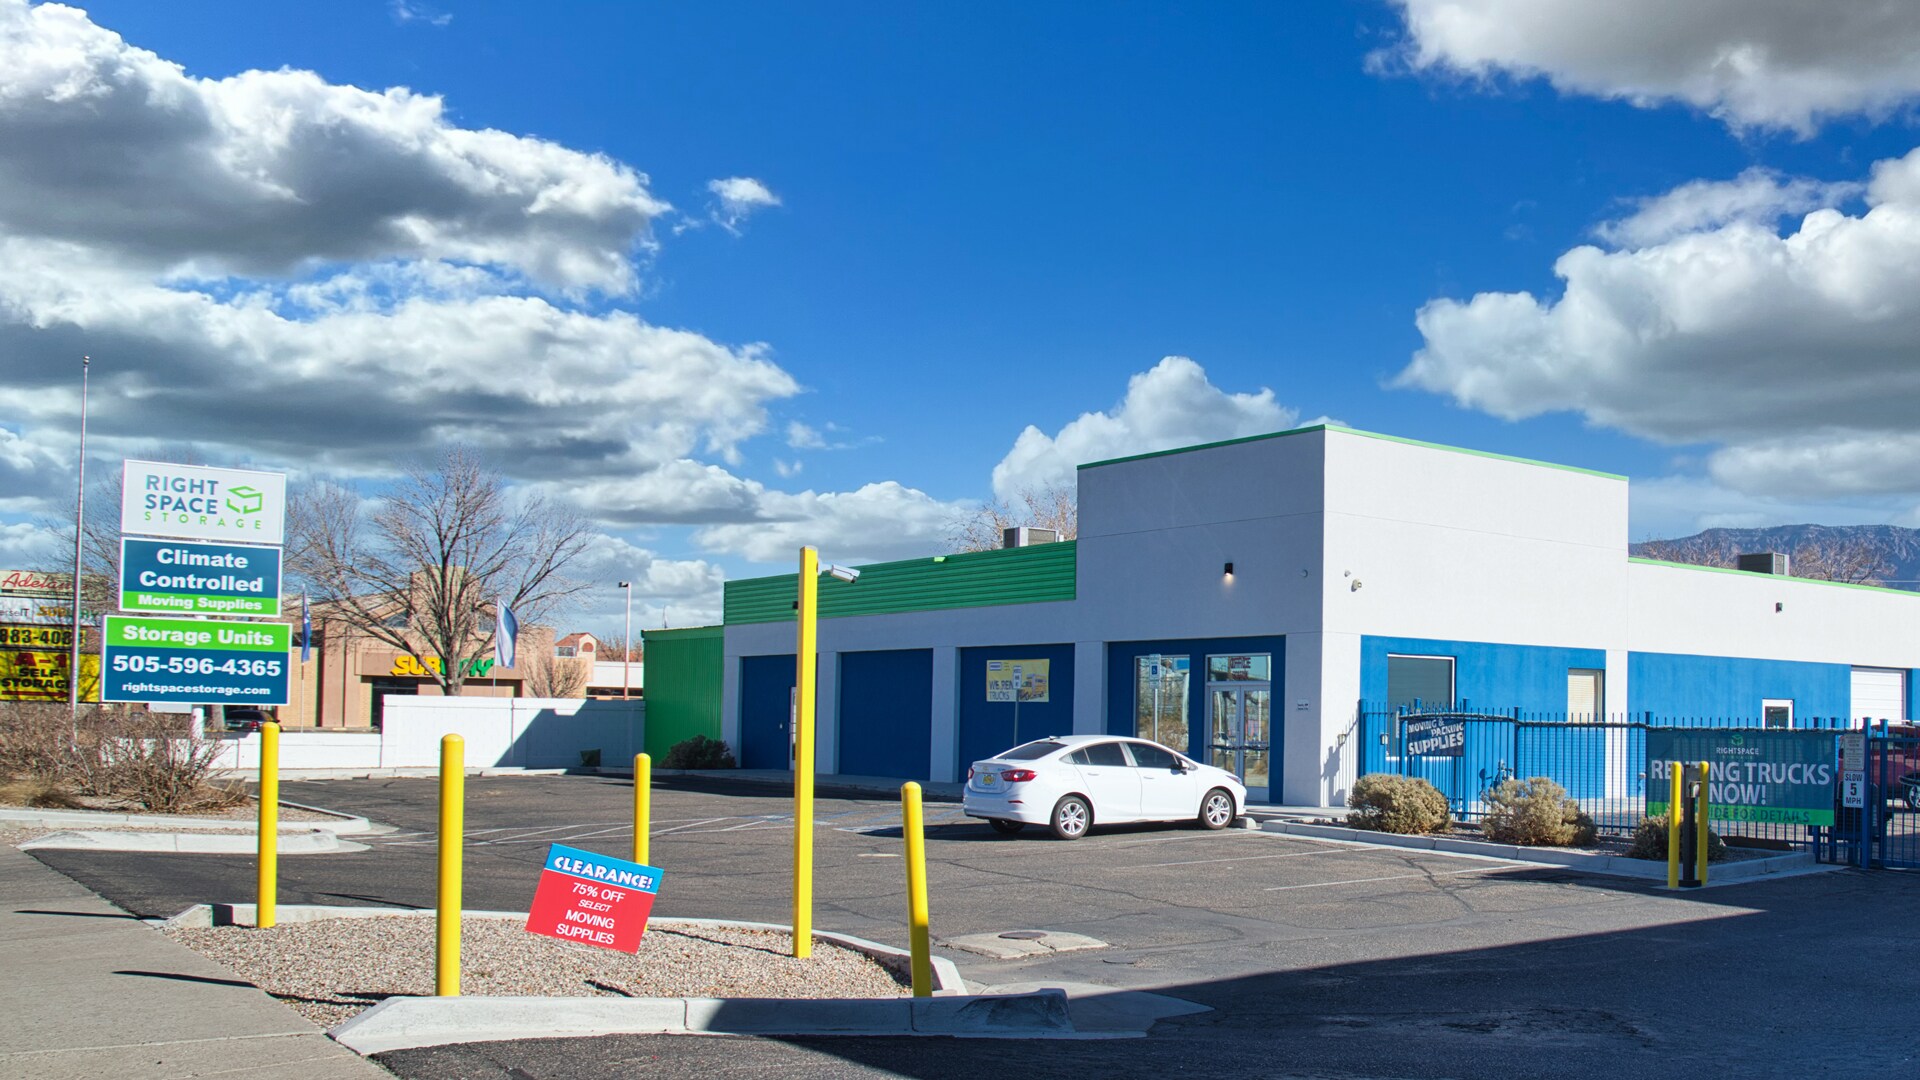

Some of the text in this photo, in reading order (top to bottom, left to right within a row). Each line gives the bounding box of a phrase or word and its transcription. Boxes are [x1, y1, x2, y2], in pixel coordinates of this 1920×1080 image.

[145, 474, 219, 496] RIGHT
[144, 493, 218, 515] SPACE
[144, 511, 262, 530] STORAGE
[156, 548, 249, 569] Climate
[139, 571, 264, 593] Controlled
[138, 594, 263, 612] Moving Supplies
[122, 625, 275, 647] Storage Units
[14, 653, 67, 668] A-1
[112, 655, 281, 677] 505-596-4365
[19, 668, 60, 678] SELF
[121, 682, 272, 697] rightspacestorage.com
[988, 690, 1010, 701] TRUCKS
[1408, 716, 1445, 734] MOVING &
[1430, 722, 1464, 737] PACKING
[1408, 731, 1464, 756] SUPPLIES
[1716, 746, 1759, 755] RIGHTSPACE
[1651, 759, 1830, 786] RENG TRUCKS
[1844, 773, 1863, 782] SLOW
[1708, 782, 1767, 805] NOW!
[1850, 782, 1857, 796] 5
[1845, 796, 1862, 805] MPH
[1733, 808, 1757, 821] FOR
[1760, 809, 1810, 823] DETAILS
[554, 856, 653, 890] CLEARANCE!
[572, 882, 626, 903] 75% OFF
[578, 898, 613, 913] SELECT
[565, 909, 615, 930] MOVING
[556, 923, 615, 945] SUPPLIES
